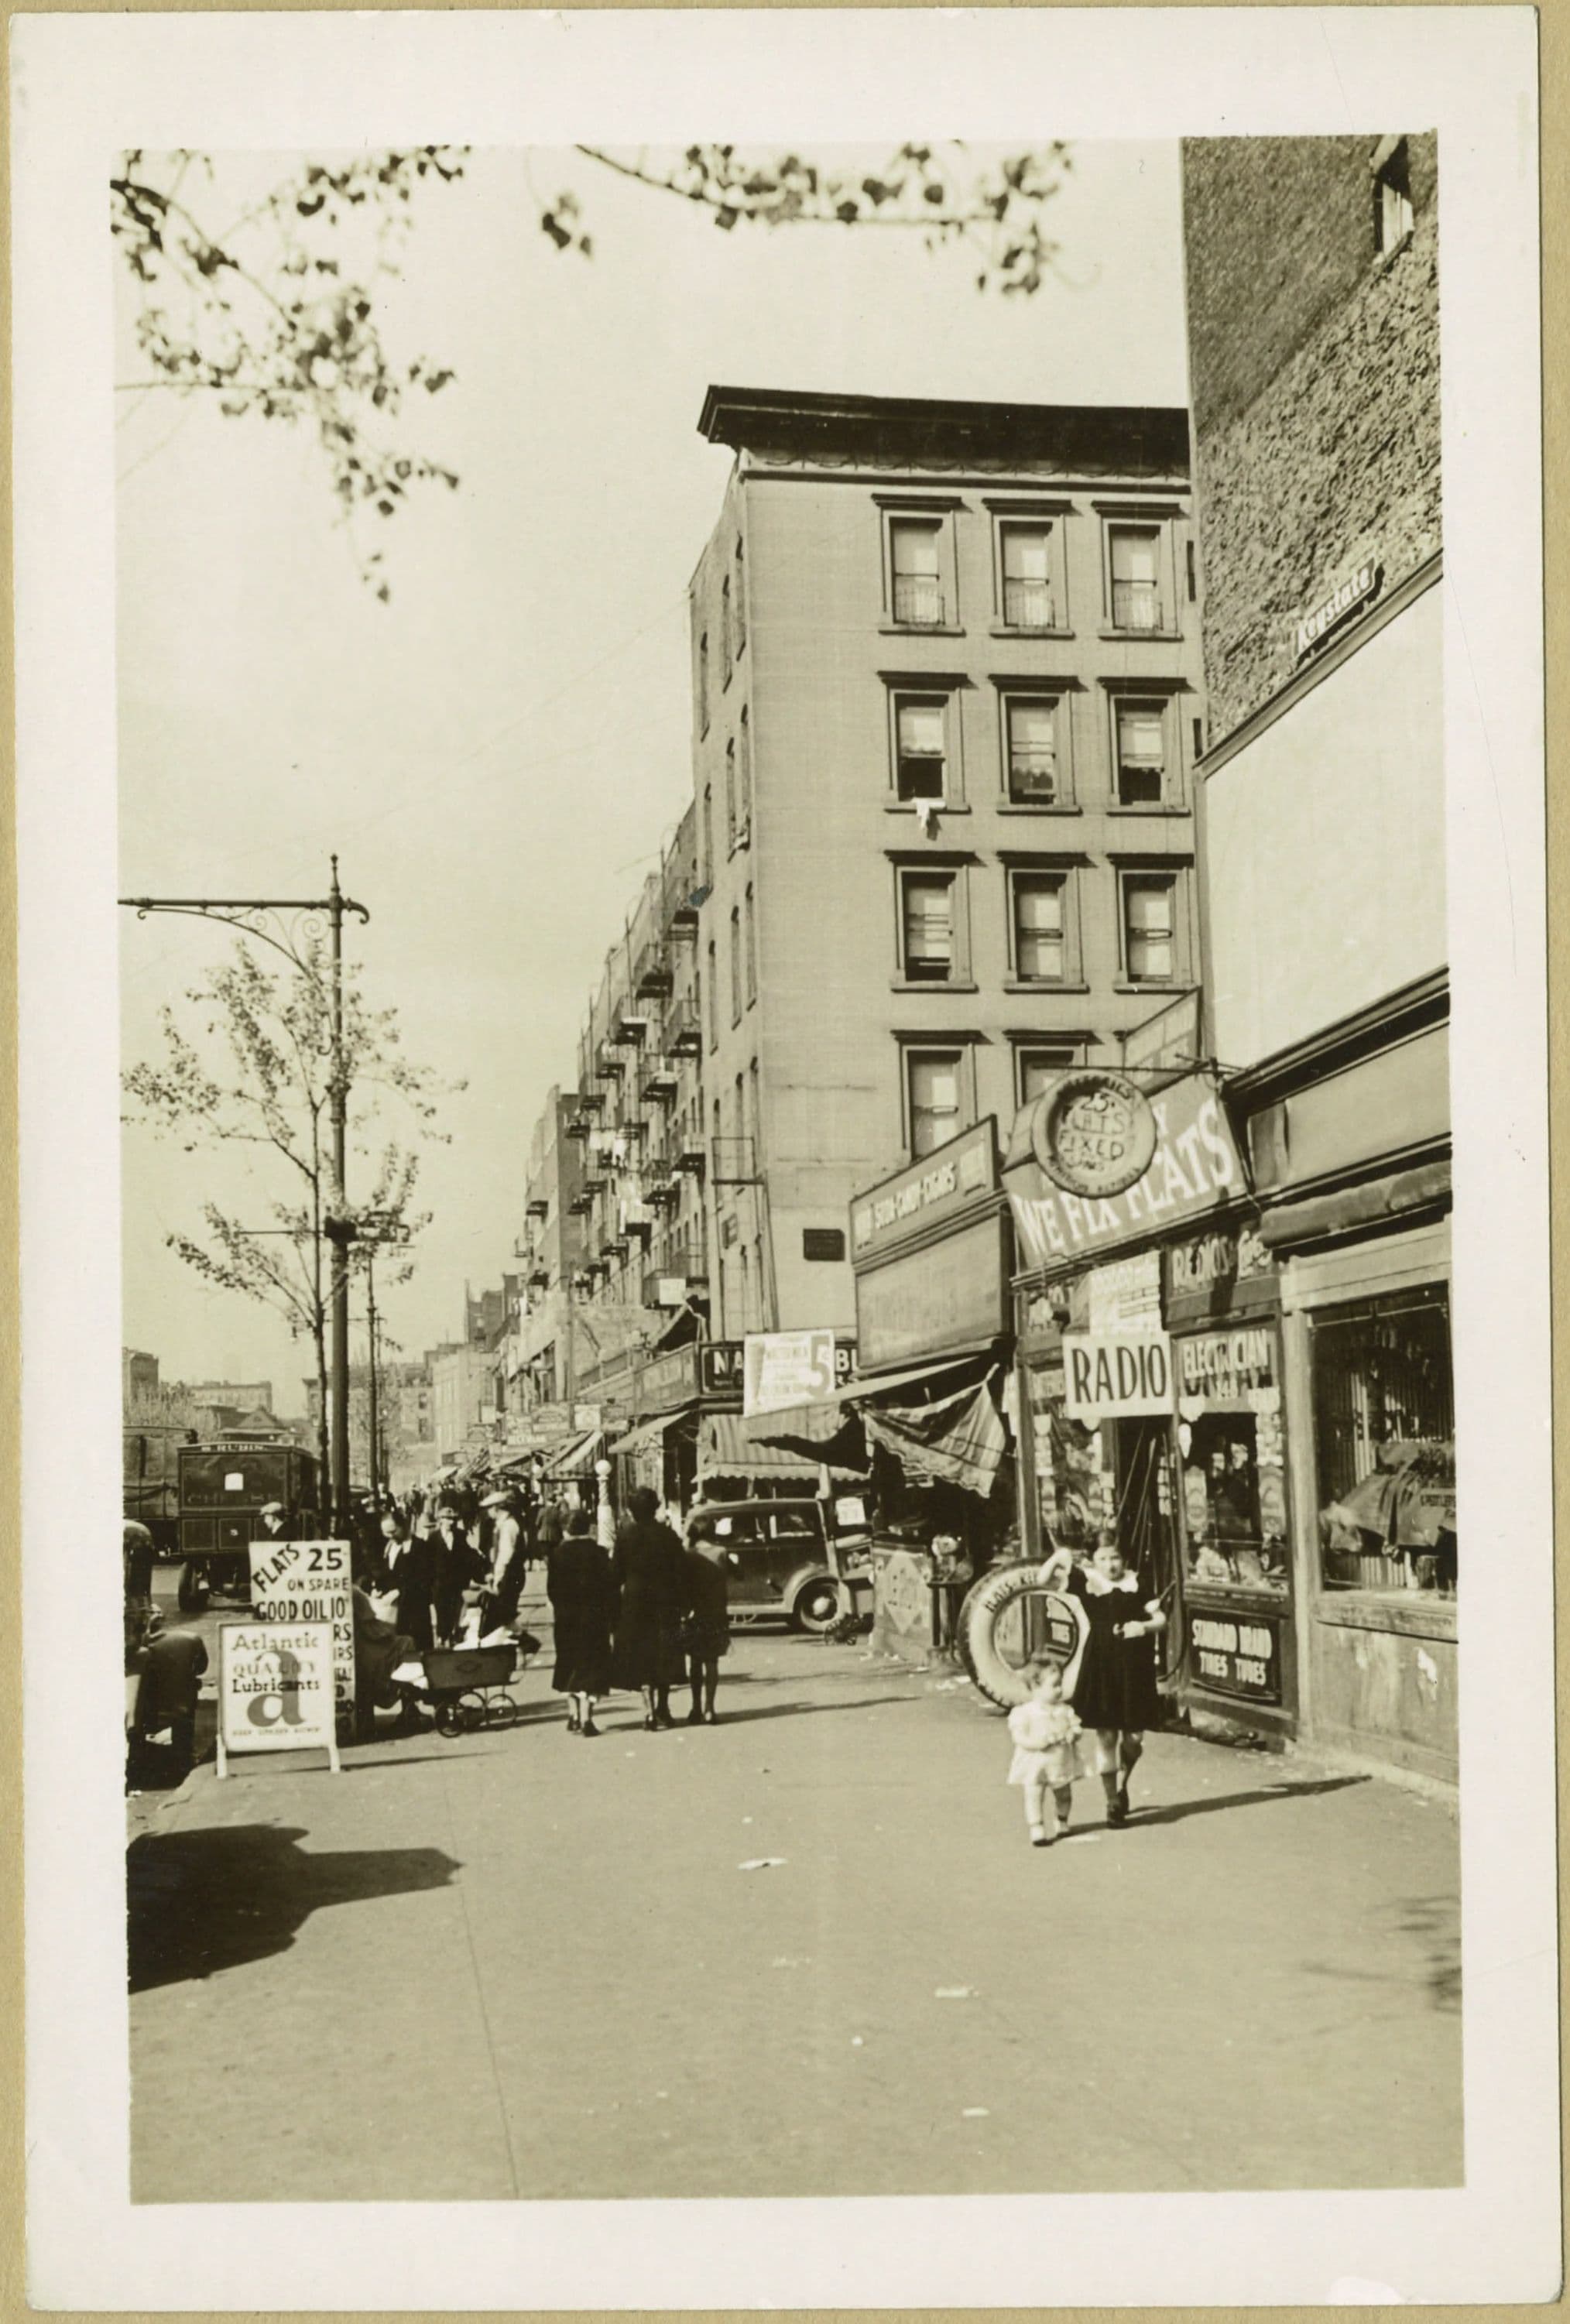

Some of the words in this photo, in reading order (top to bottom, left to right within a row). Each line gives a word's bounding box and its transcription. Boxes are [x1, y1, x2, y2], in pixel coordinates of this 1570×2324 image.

[1011, 1195, 1064, 1256] WE
[1125, 1099, 1233, 1220] FLATS
[1071, 1344, 1167, 1404] RADIO
[252, 1542, 300, 1594] FLATS
[287, 1578, 305, 1592] ON
[309, 1577, 349, 1592] SPARE
[255, 1599, 298, 1621] GOOD
[302, 1599, 327, 1620] OIL
[231, 1632, 319, 1650] Atlantic
[232, 1678, 320, 1694] Lubricants
